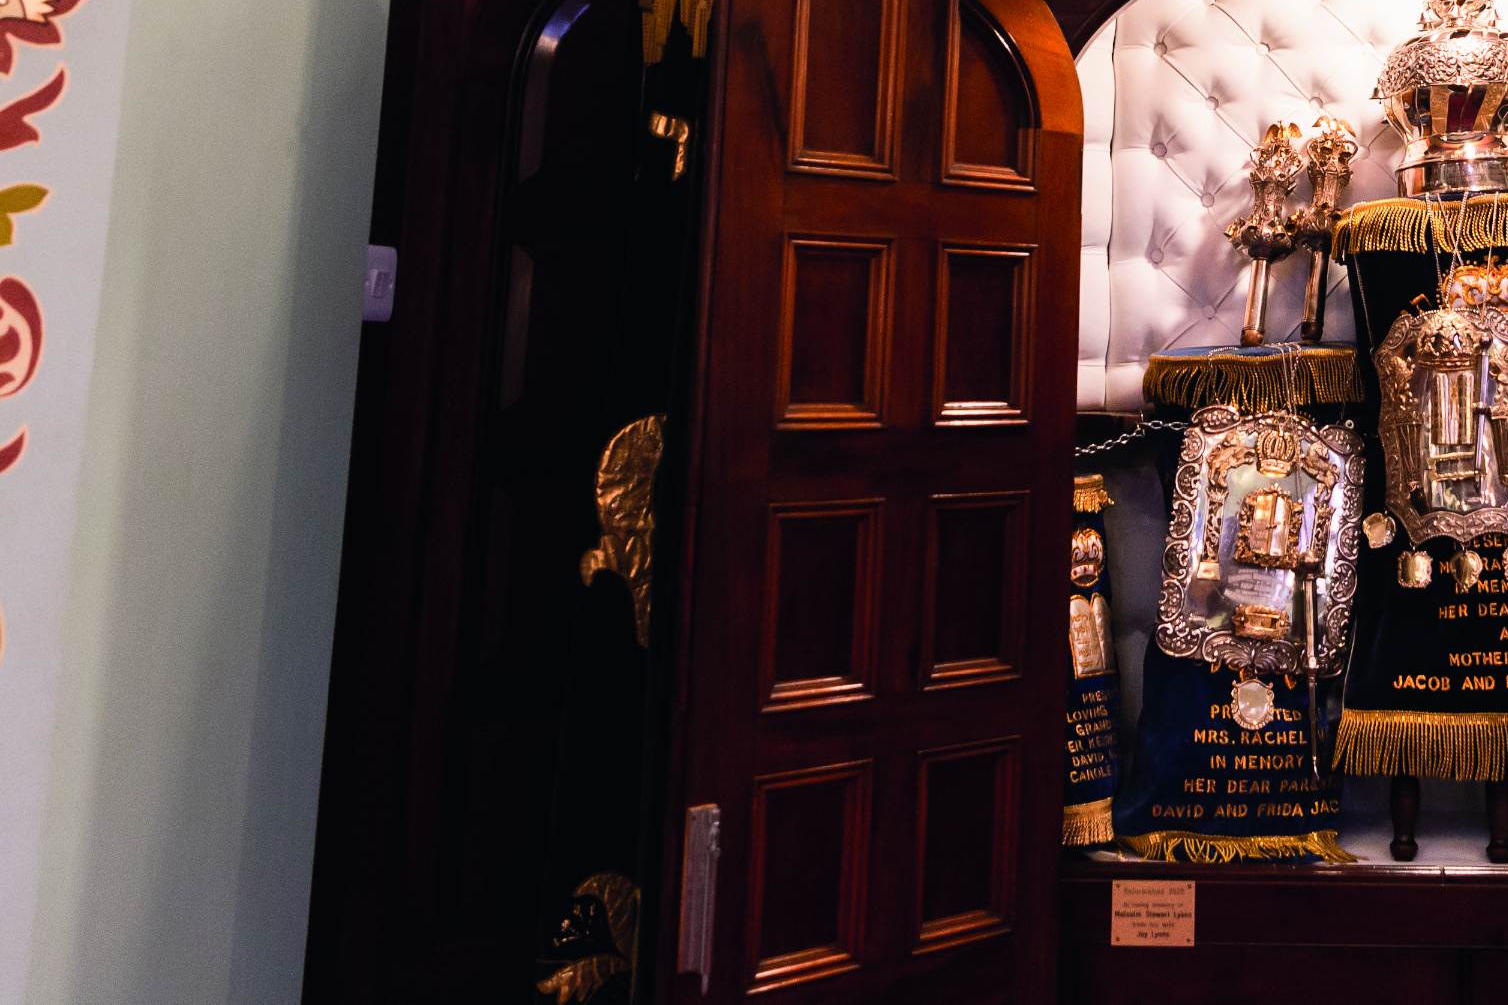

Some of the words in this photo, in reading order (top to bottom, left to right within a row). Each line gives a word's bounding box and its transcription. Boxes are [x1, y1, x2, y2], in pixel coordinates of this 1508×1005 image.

[1439, 603, 1469, 619] HER
[1393, 674, 1451, 691] JACOB
[1461, 675, 1496, 691] AND
[1210, 704, 1303, 722] PRTED
[1194, 728, 1236, 744] MRS.
[1240, 730, 1307, 745] RACHEL
[1210, 754, 1227, 770] IN
[1234, 755, 1304, 770] MEMORY
[1184, 778, 1217, 793] HER
[1227, 779, 1271, 794] DEAR
[1152, 803, 1204, 818] DAVID
[1214, 803, 1249, 818] AND
[1257, 803, 1304, 818] FRIDA
